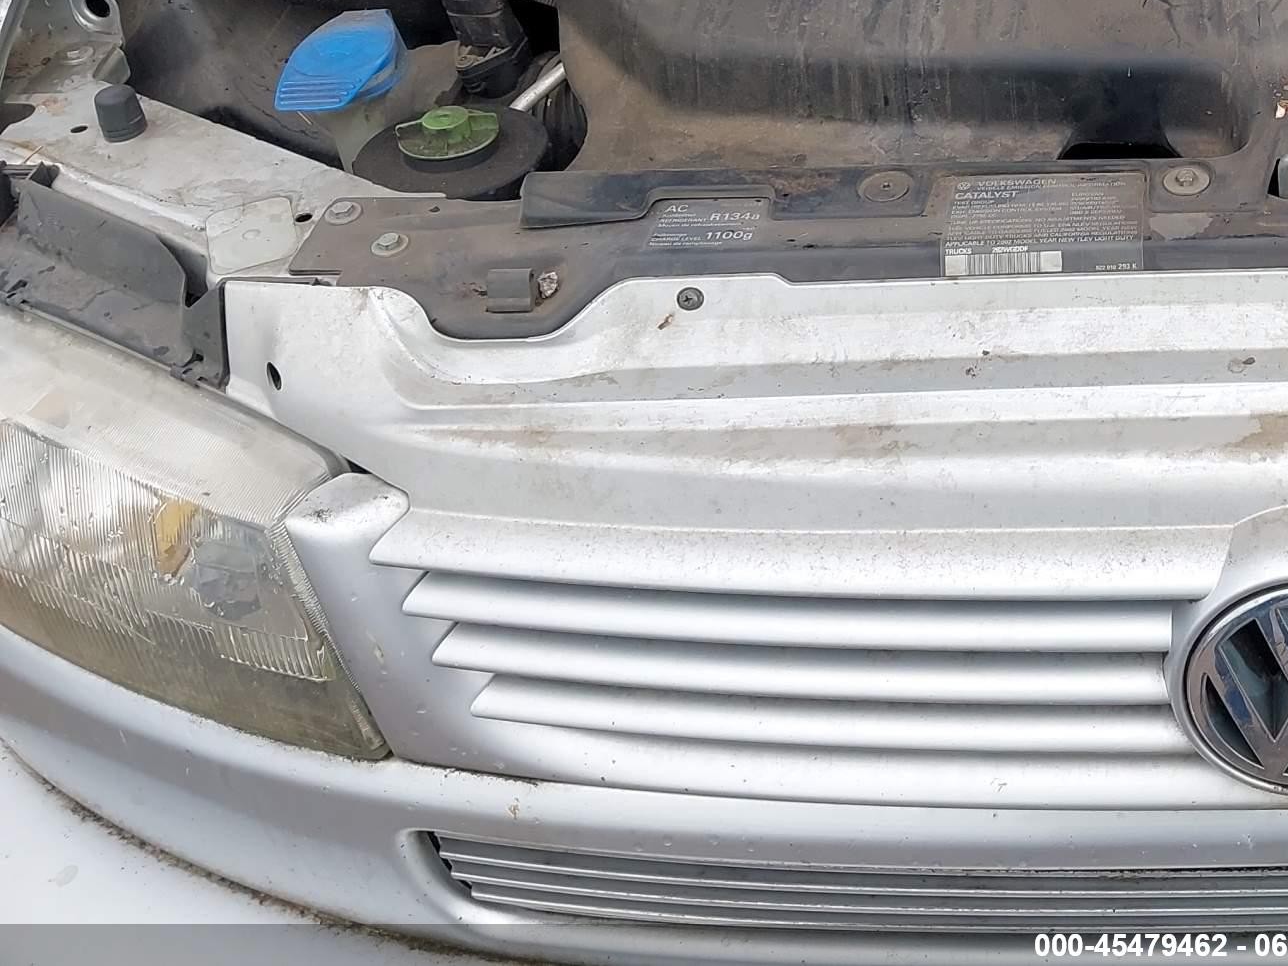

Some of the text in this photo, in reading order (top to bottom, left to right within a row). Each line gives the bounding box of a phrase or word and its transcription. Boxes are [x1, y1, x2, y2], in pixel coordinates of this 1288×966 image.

[977, 178, 1057, 187] VOLKSWAGEN
[955, 190, 1019, 200] CATALYST
[664, 204, 689, 213] AC
[709, 212, 760, 221] R134a
[706, 230, 753, 241] 1100g
[945, 247, 973, 255] TRUCKS
[1117, 262, 1131, 270] 293
